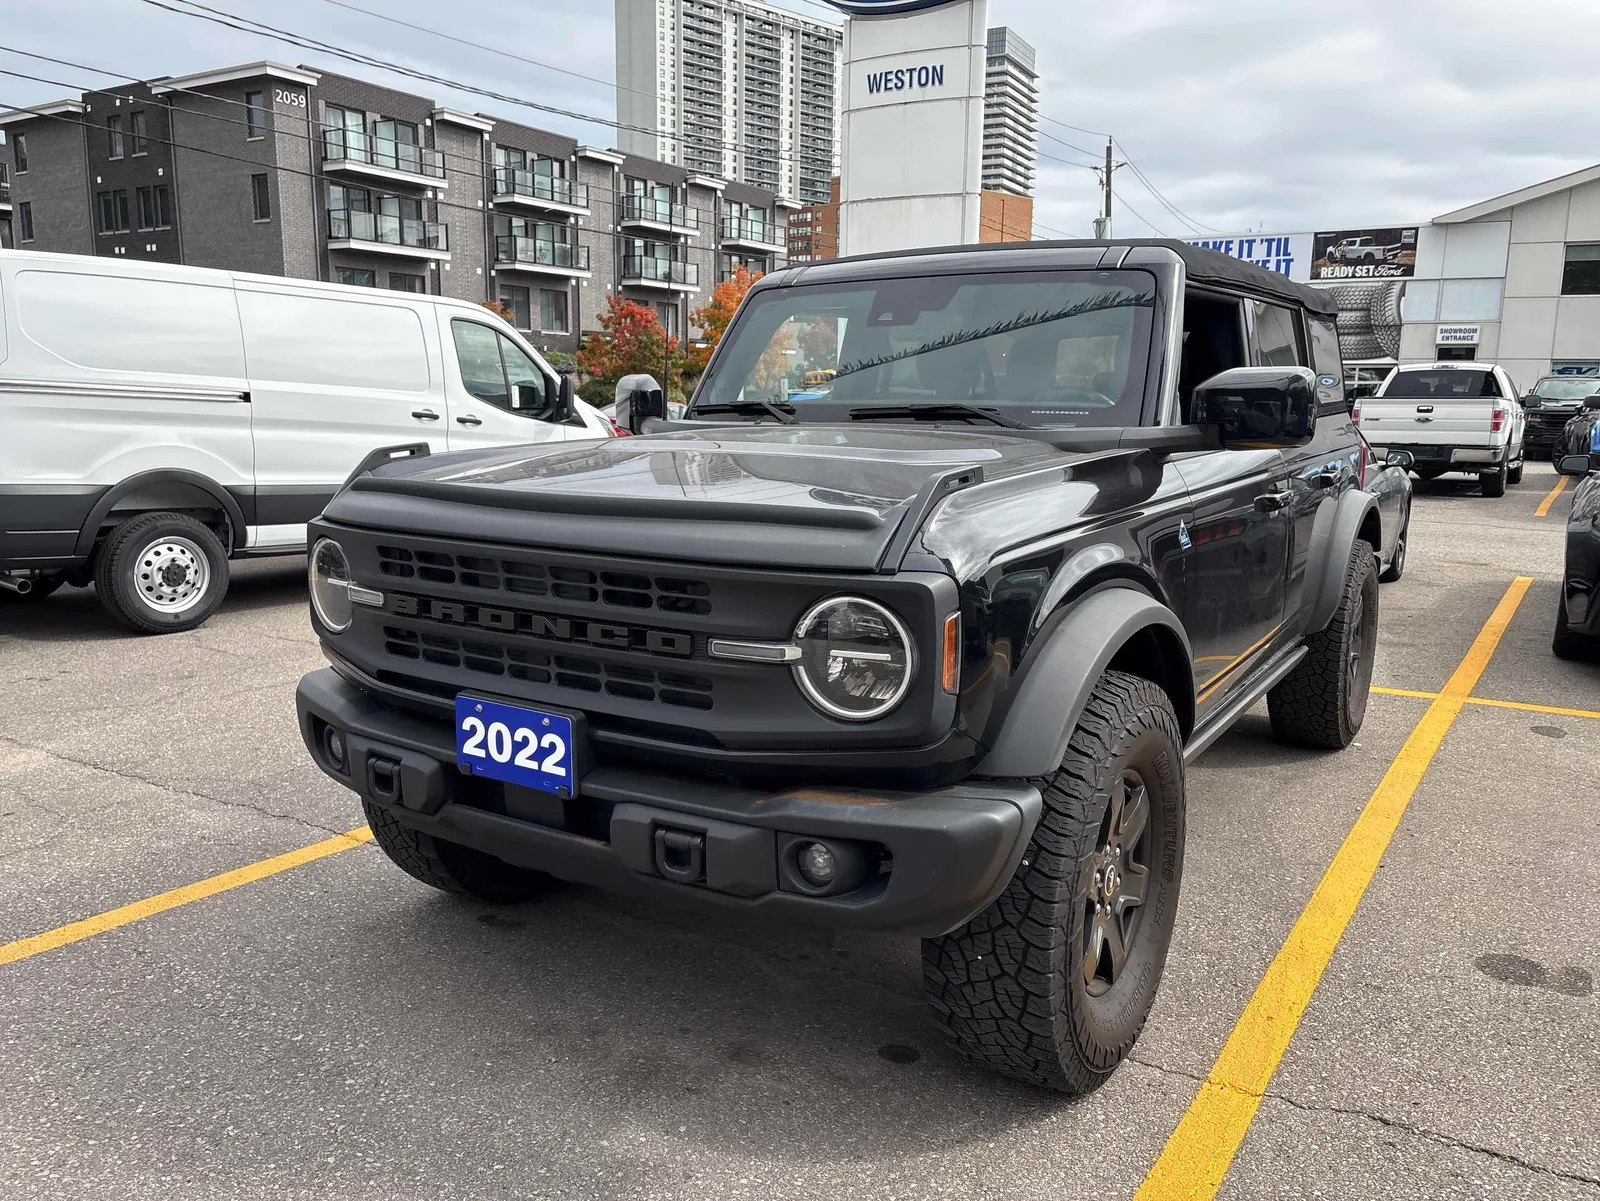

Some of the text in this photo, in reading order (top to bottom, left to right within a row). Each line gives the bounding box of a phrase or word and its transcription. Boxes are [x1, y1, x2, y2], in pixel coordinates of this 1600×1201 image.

[867, 65, 944, 94] WESTON
[275, 89, 306, 108] 2059
[1238, 239, 1256, 259] IT
[1320, 264, 1406, 278] READY SET Ford
[386, 593, 693, 656] BRONCO
[461, 716, 567, 777] 2022
